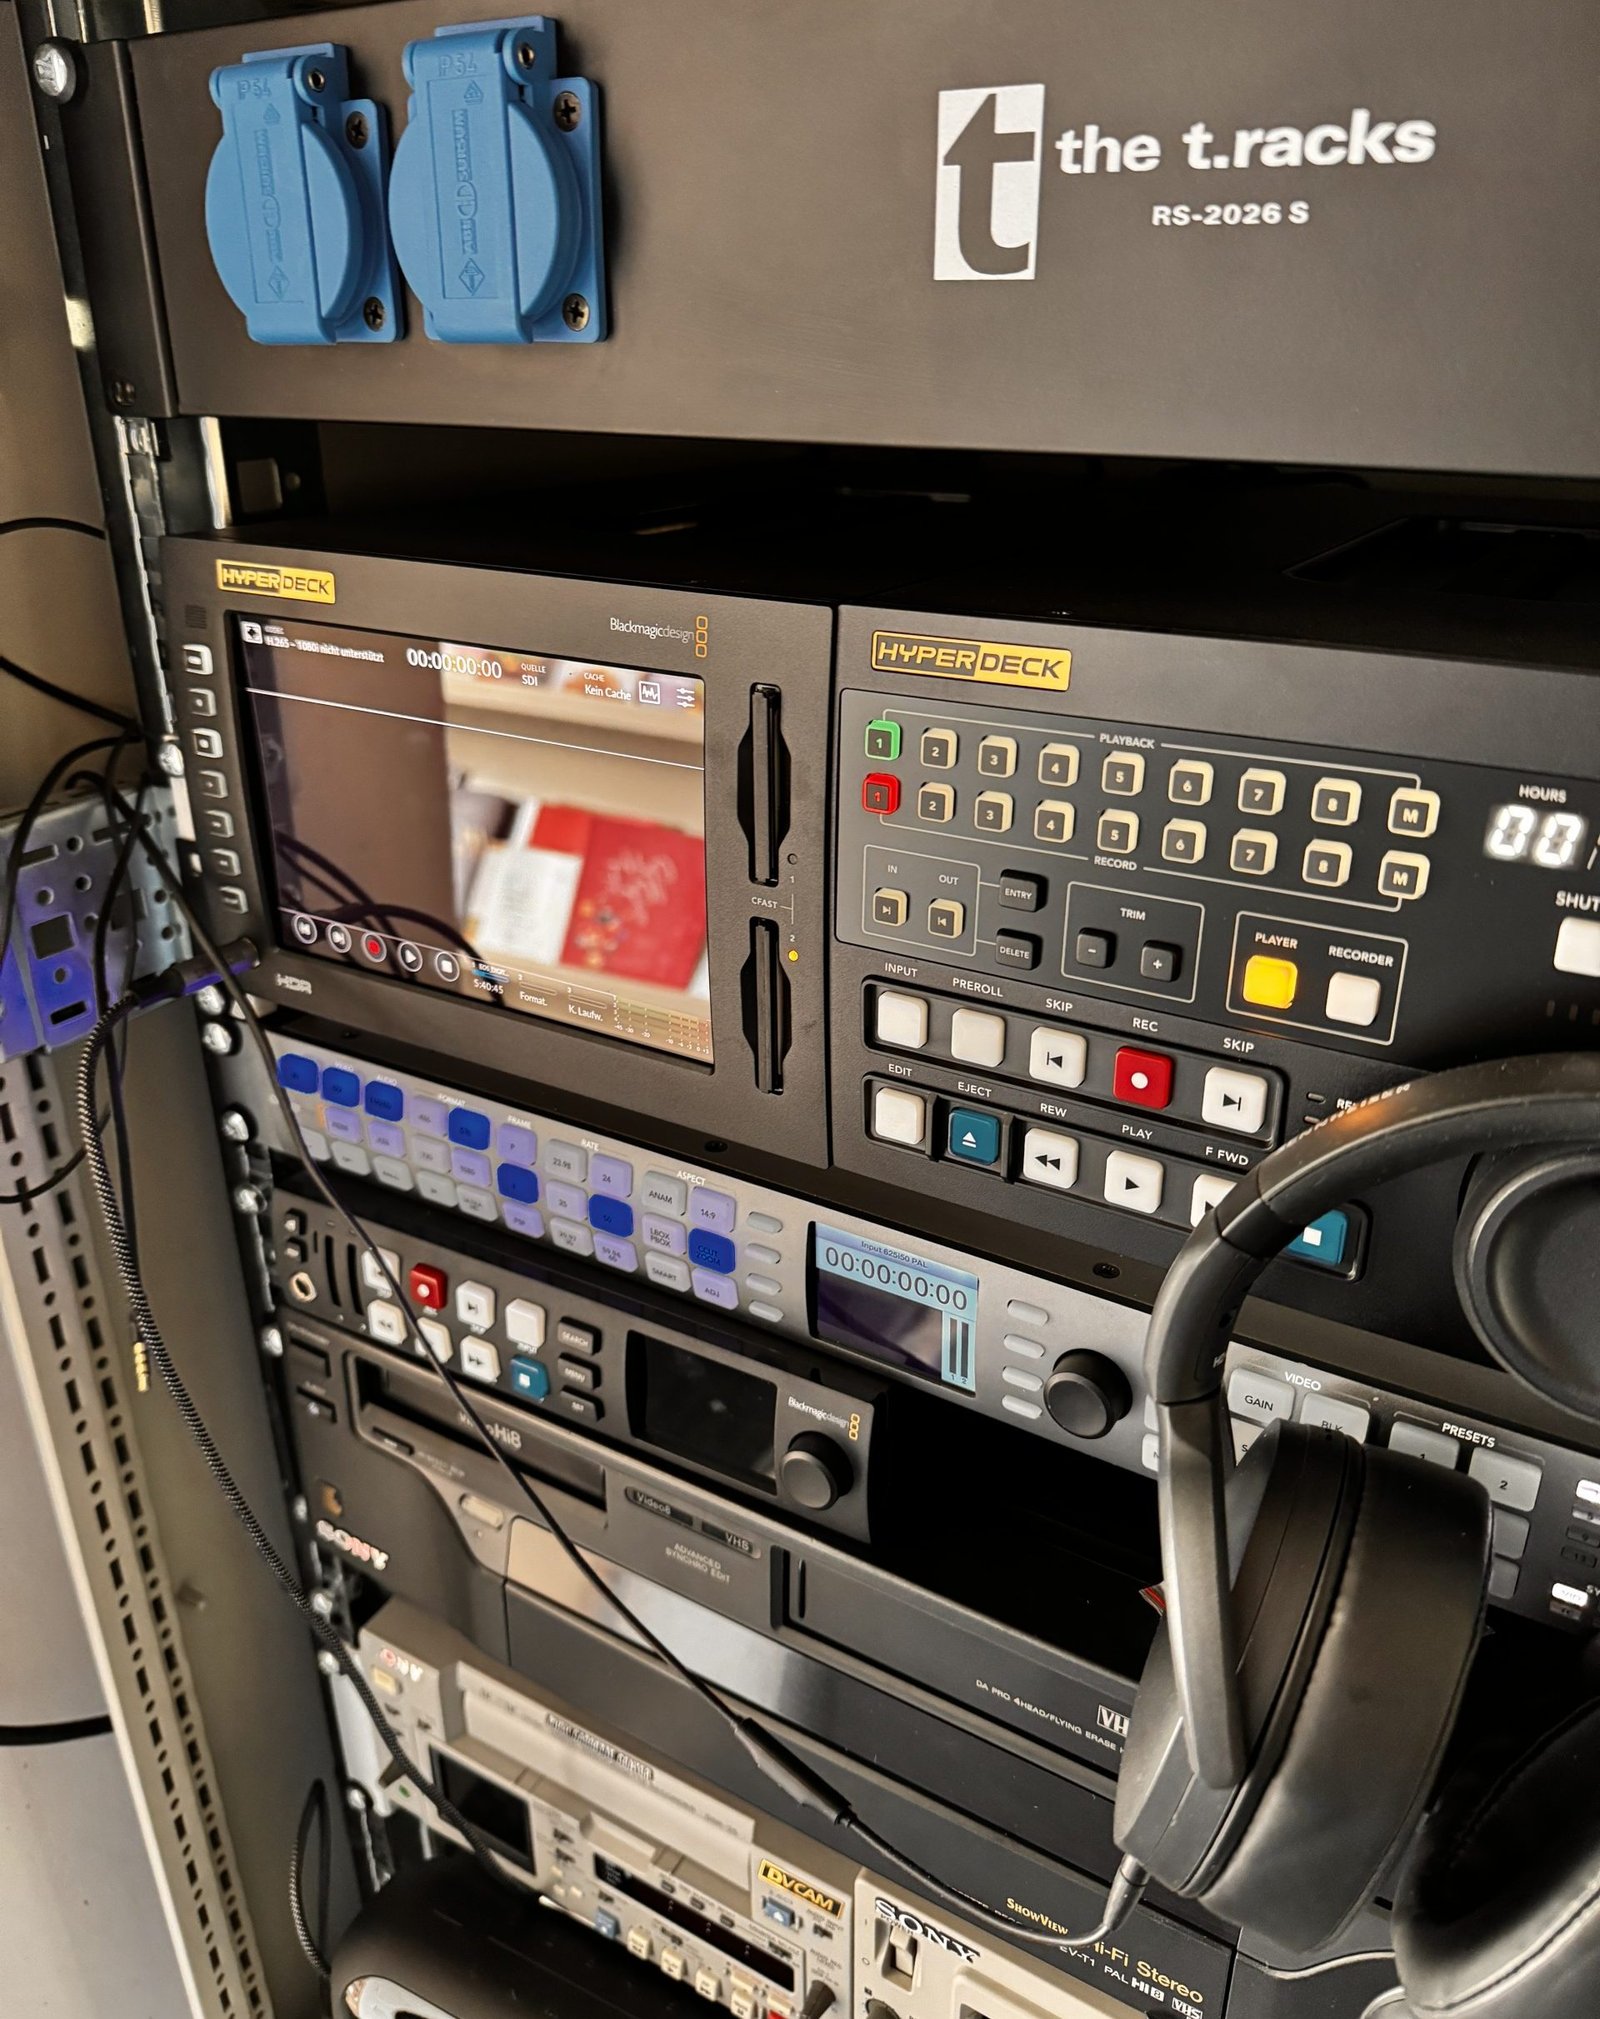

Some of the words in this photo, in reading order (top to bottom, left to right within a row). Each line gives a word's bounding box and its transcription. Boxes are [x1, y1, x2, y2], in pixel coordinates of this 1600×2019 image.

[1055, 125, 1161, 174] the
[1182, 107, 1437, 171] t.racks
[1152, 203, 1282, 226] RS-2026
[1288, 201, 1310, 224] S
[221, 567, 332, 597] HYPERDECK
[320, 643, 340, 656] nicht
[406, 648, 503, 679] 00:00:00:00
[877, 640, 1065, 680] HYPERDECK
[521, 662, 546, 675] QUELLE
[522, 674, 538, 687] SDI
[583, 671, 606, 683] CACHE
[584, 683, 604, 697] Kein
[605, 686, 632, 701] Cache
[876, 738, 883, 749] 1
[1099, 733, 1155, 749] PLAYBACK
[932, 747, 940, 757] 2
[990, 755, 998, 765] 3
[1051, 763, 1059, 774] 4
[1116, 771, 1124, 783] 5
[1183, 781, 1192, 792] 6
[1519, 784, 1567, 804] HOURS
[874, 791, 881, 802] 1
[1254, 789, 1263, 802] 7
[929, 801, 937, 811] 2
[986, 810, 994, 820] 3
[1403, 808, 1419, 824] M
[1047, 820, 1055, 830] 4
[1111, 830, 1119, 841] 5
[1488, 804, 1582, 867] 00
[1176, 839, 1185, 851] 6
[1094, 855, 1137, 871] RECORD
[1246, 850, 1255, 862] 7
[887, 864, 898, 874] IN
[938, 874, 959, 886] OUT
[1393, 871, 1408, 886] M
[1004, 888, 1032, 900] ENTRY
[751, 896, 778, 909] CFAST
[1120, 907, 1146, 921] TRIM
[789, 934, 795, 942] 2
[1255, 932, 1298, 949] PLAYER
[999, 946, 1030, 959] DELETE
[1328, 945, 1394, 967] RECORDER
[885, 963, 918, 977] INPUT
[473, 979, 504, 995] 5:40:45
[952, 978, 1004, 998] PREROLL
[519, 991, 548, 1006] Format.
[1046, 998, 1074, 1012] SKIP
[1132, 1017, 1159, 1032] REC
[1223, 1038, 1255, 1053] SKIP
[888, 1063, 913, 1077] EDIT
[957, 1082, 992, 1098] EJECT
[1040, 1103, 1068, 1118] REW
[508, 1115, 532, 1130] FRAME
[1121, 1125, 1153, 1141] PLAY
[581, 1139, 599, 1152] RATE
[1205, 1146, 1214, 1157] F
[1217, 1149, 1250, 1166] FWD
[602, 1174, 612, 1183] 24
[676, 1170, 706, 1186] ASPECT
[648, 1190, 673, 1205] ANAM
[911, 1257, 928, 1269] PAL
[825, 1246, 967, 1311] 00:00:00:00
[1284, 1371, 1322, 1391] VIDEO
[1244, 1394, 1274, 1412] GAIN
[1441, 1422, 1496, 1448] PRESETS
[1499, 1480, 1509, 1490] 2
[674, 1542, 722, 1570] ADVANCED
[710, 1568, 731, 1584] EDIT
[976, 1679, 988, 1691] DA
[992, 1686, 1010, 1701] PRO
[1085, 1730, 1116, 1751] ERASE
[1100, 1707, 1130, 1736] VH
[765, 1865, 835, 1913] DVCAM
[875, 1897, 981, 1964] SONY
[1104, 1965, 1129, 1985] PAL
[1136, 1960, 1204, 2004] Stereo
